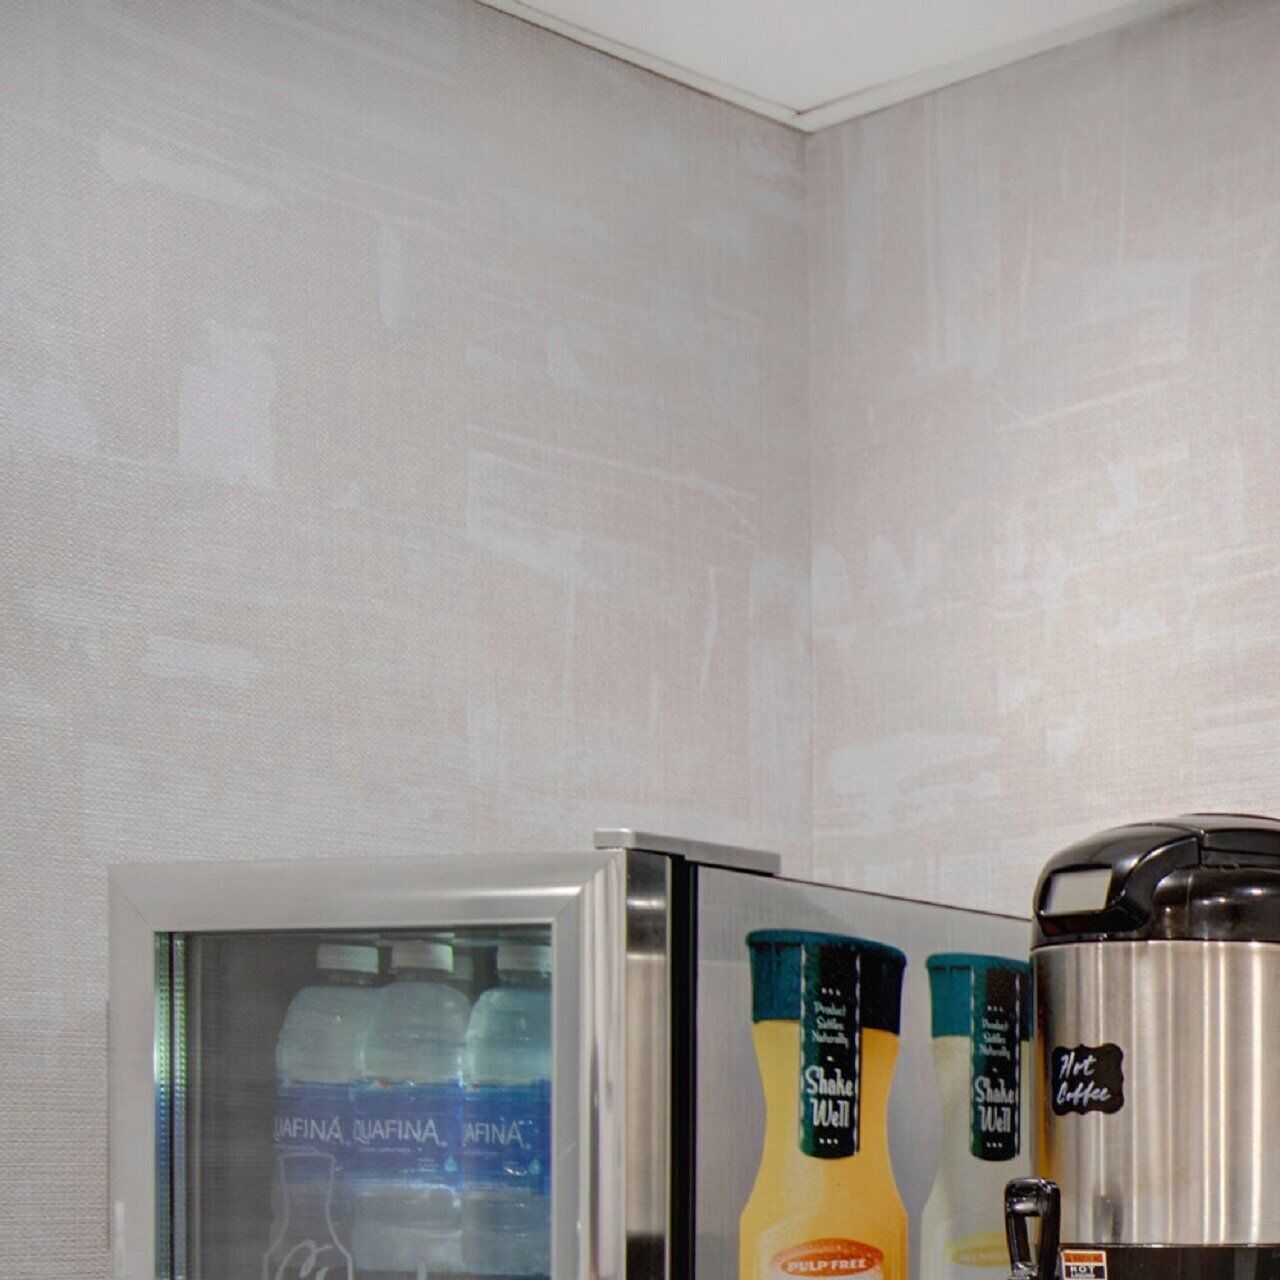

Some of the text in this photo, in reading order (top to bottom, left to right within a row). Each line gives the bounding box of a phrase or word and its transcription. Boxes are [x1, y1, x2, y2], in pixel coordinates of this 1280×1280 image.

[1058, 1050, 1097, 1080] Hot
[804, 1065, 854, 1098] Shake
[974, 1075, 1015, 1104] Shake
[1056, 1081, 1112, 1108] Coffee
[810, 1099, 850, 1128] Well
[981, 1105, 1011, 1133] Well
[786, 1258, 868, 1272] PULP FREE
